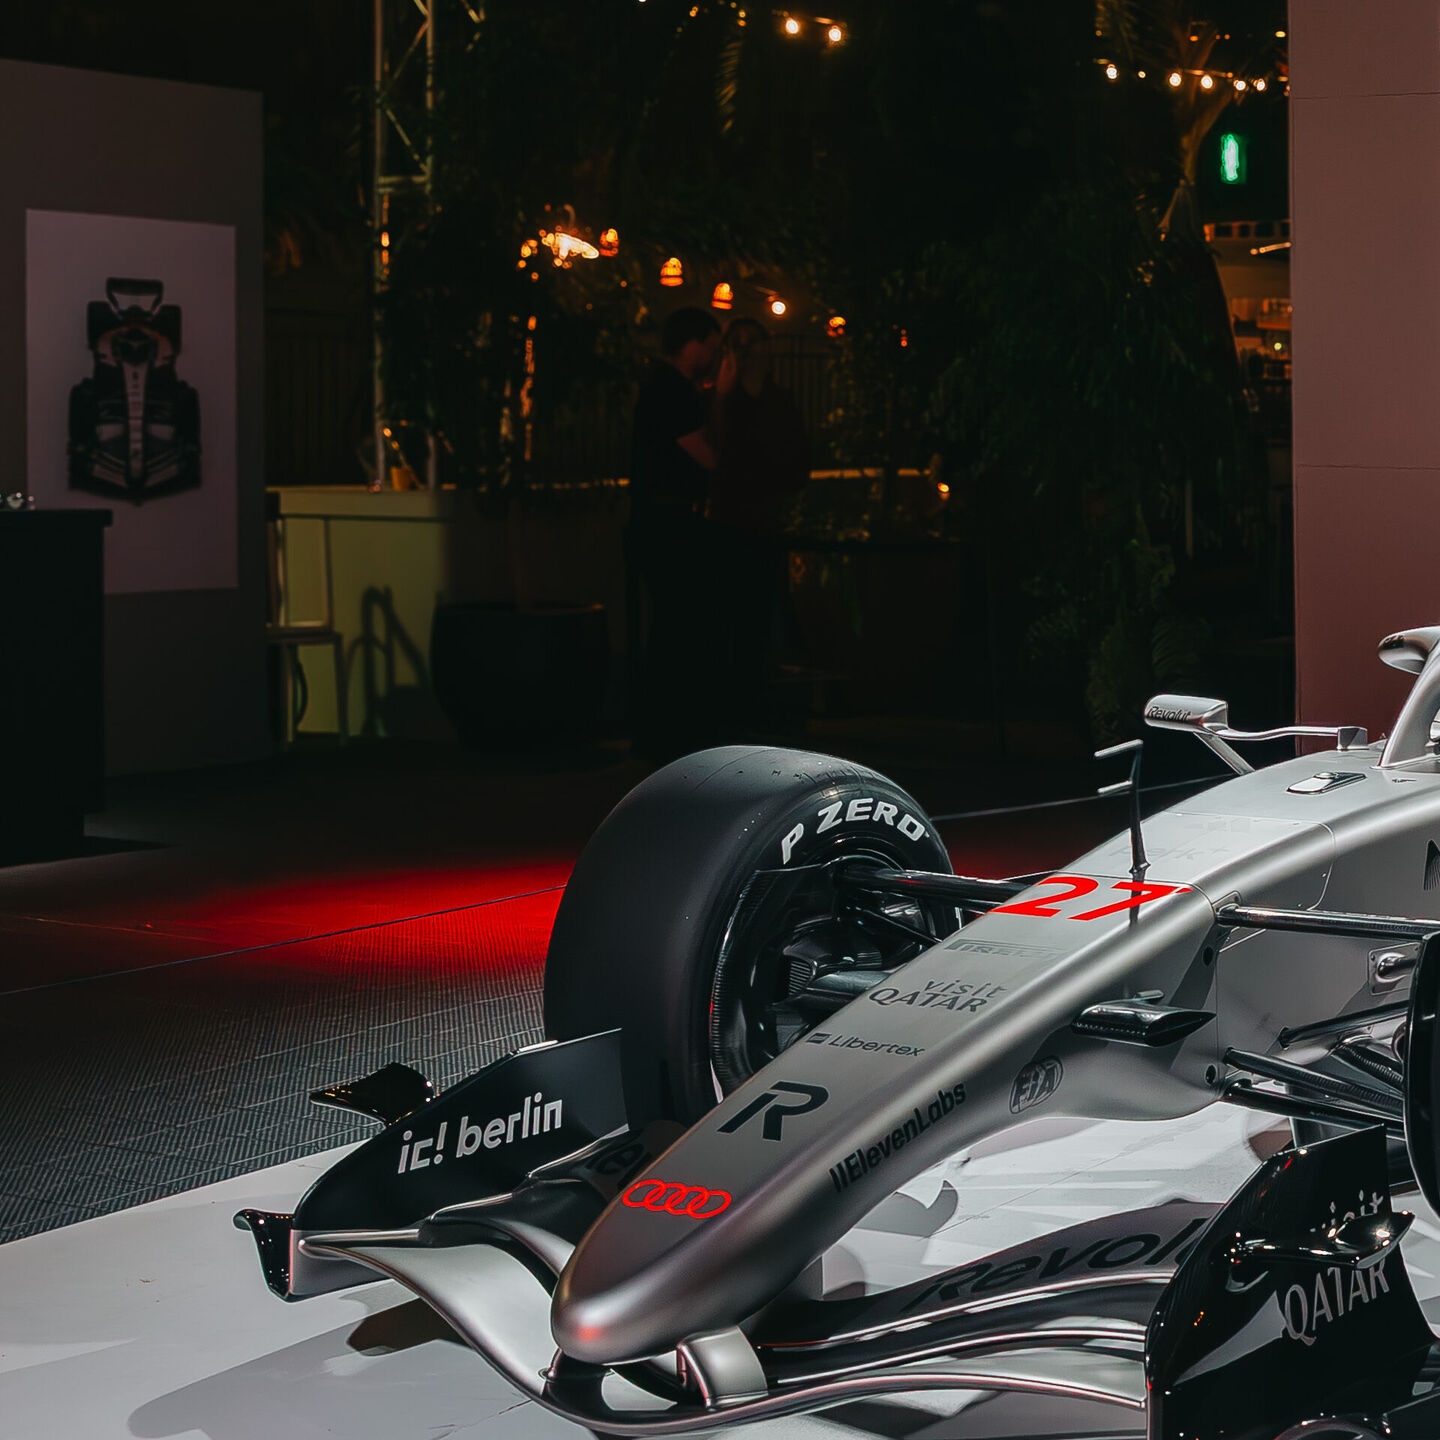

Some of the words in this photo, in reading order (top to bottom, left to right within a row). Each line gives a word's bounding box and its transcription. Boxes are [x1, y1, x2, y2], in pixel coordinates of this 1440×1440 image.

[1147, 705, 1192, 722] Revolut
[781, 823, 805, 865] P
[816, 797, 925, 842] ZERO
[987, 876, 1193, 921] 27
[868, 987, 988, 1013] QATAR
[923, 979, 1006, 998] visit
[828, 1033, 926, 1058] Libertex
[716, 1080, 829, 1142] R
[397, 1121, 448, 1175] ic!
[455, 1091, 563, 1159] berlin
